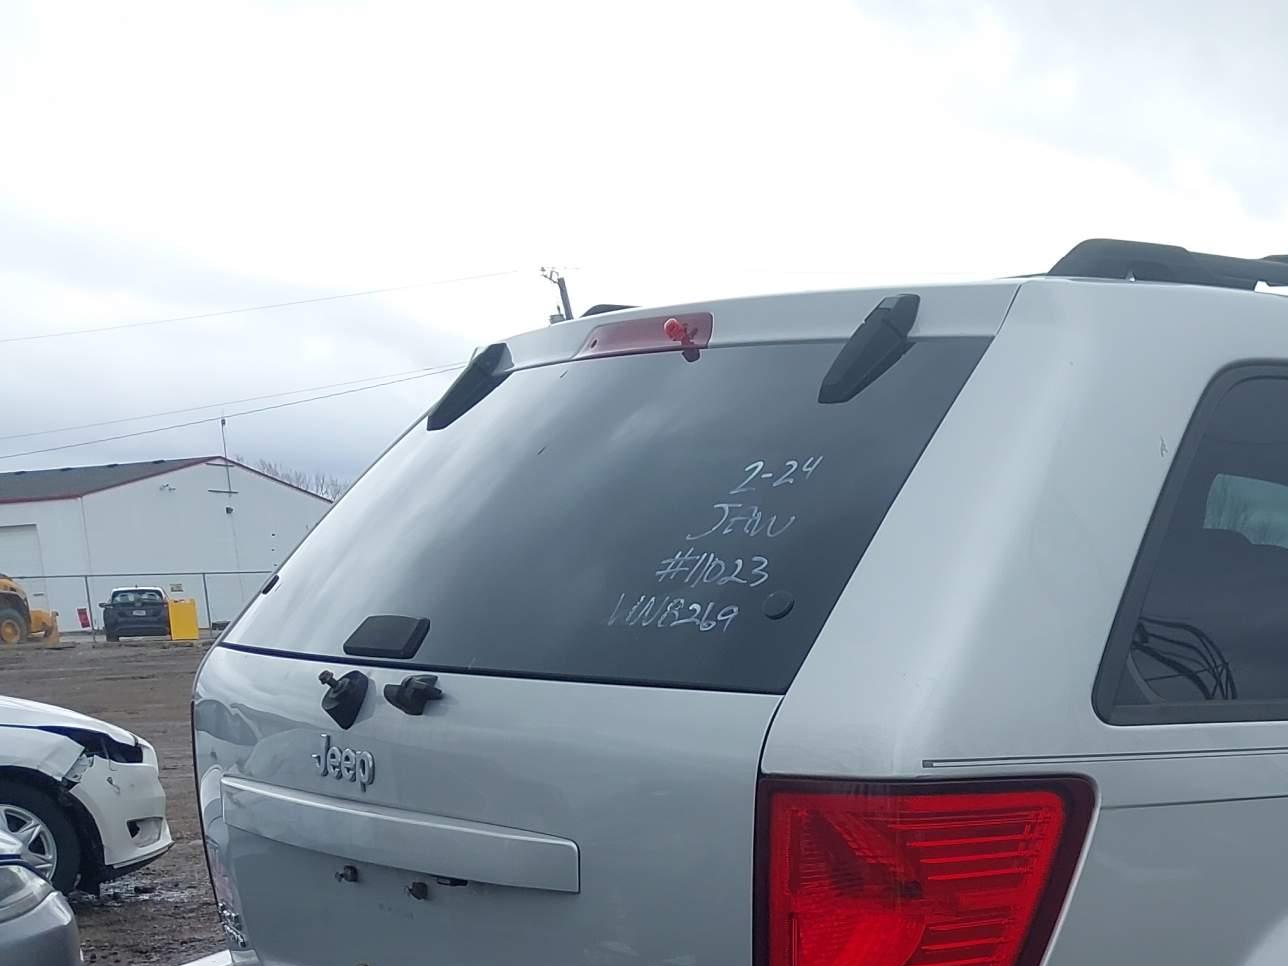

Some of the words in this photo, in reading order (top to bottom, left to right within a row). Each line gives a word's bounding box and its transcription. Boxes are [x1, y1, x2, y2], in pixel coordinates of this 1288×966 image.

[729, 455, 824, 495] 2-24
[655, 547, 769, 588] #11023
[311, 733, 376, 793] Jeep
